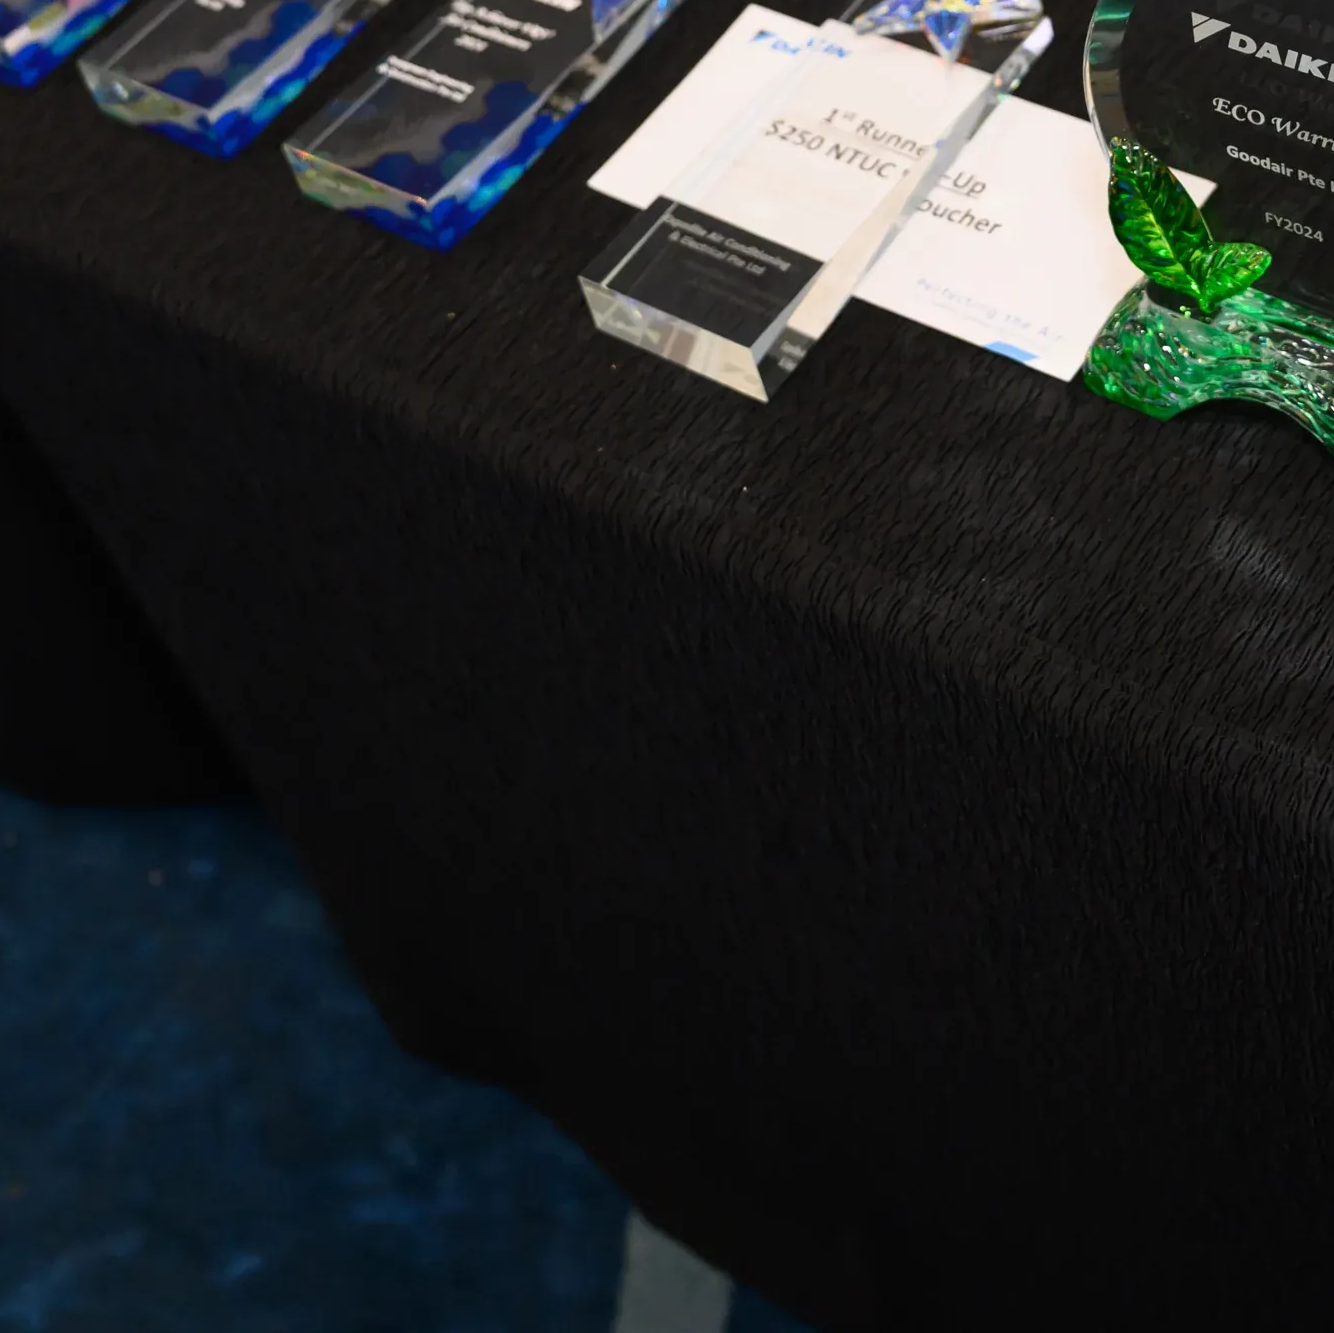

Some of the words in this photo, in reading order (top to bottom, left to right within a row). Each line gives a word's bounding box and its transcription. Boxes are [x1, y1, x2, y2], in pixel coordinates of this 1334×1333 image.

[1212, 97, 1266, 126] ECO
[765, 119, 825, 152] $250
[825, 142, 897, 180] NTUC
[1225, 144, 1294, 178] Goodair
[1297, 168, 1326, 189] Pte
[1264, 211, 1324, 243] FY2024
